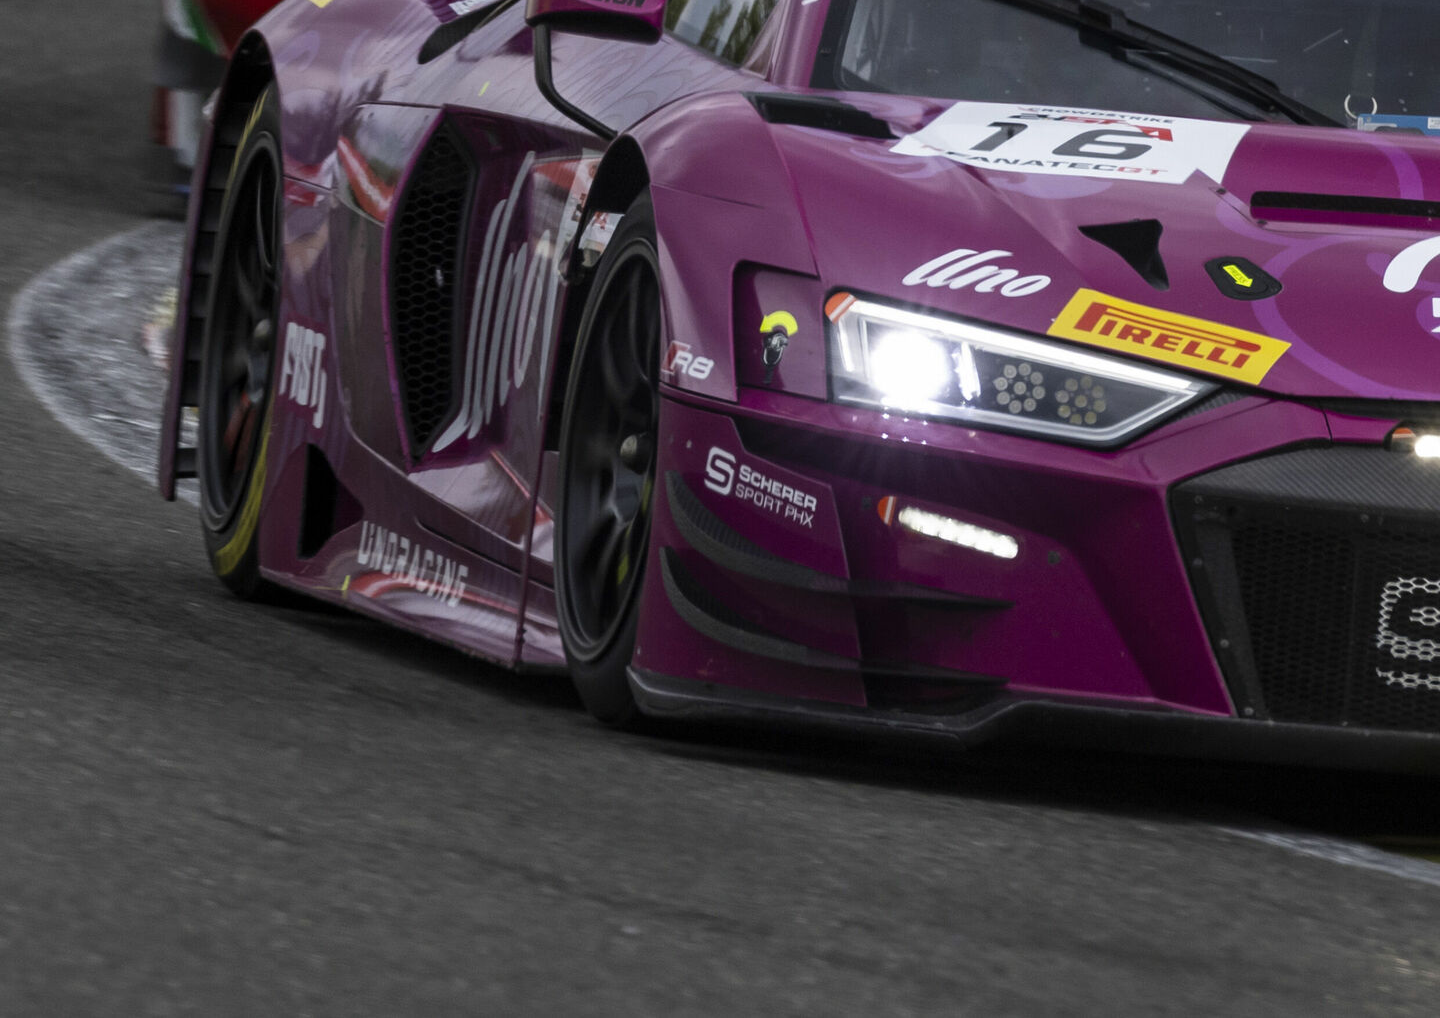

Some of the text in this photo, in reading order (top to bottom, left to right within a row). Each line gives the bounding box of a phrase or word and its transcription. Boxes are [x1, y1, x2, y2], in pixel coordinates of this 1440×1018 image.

[970, 122, 1153, 160] 16
[901, 249, 1051, 297] Uno
[1073, 302, 1261, 370] PIRELLI
[670, 350, 715, 380] R8
[735, 484, 815, 529] SPORT PHX
[739, 464, 817, 512] SCHERER
